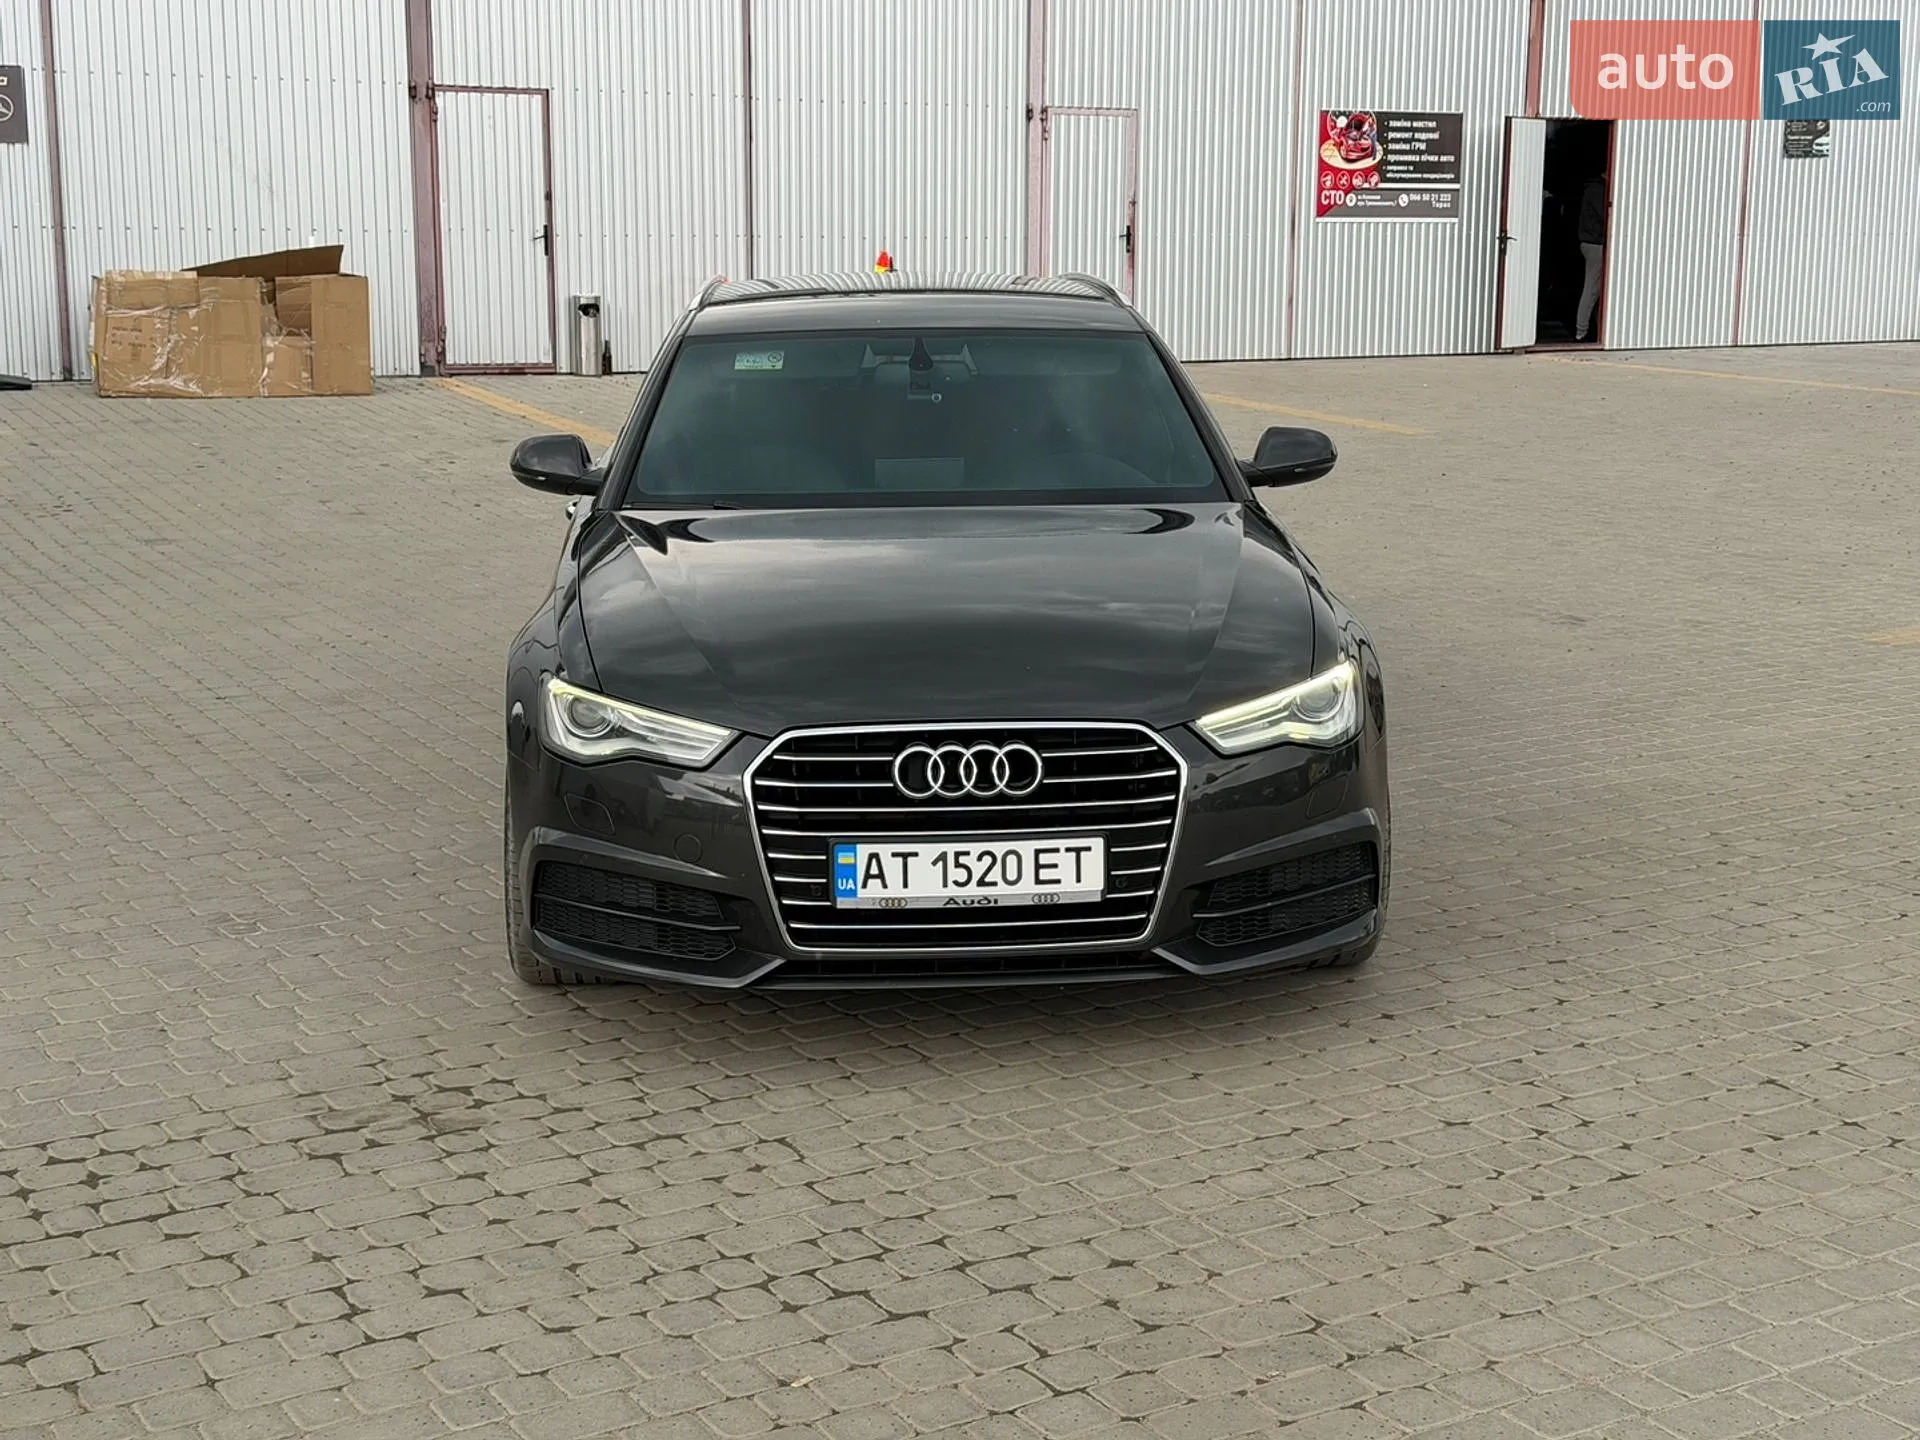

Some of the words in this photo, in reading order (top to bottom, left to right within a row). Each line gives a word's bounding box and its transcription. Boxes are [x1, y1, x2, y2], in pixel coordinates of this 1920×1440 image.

[1321, 190, 1345, 205] СТО
[861, 851, 919, 890] AT
[931, 849, 1023, 889] 1520
[1034, 846, 1092, 886] ET
[838, 879, 856, 891] UA
[943, 896, 1000, 907] Audi
